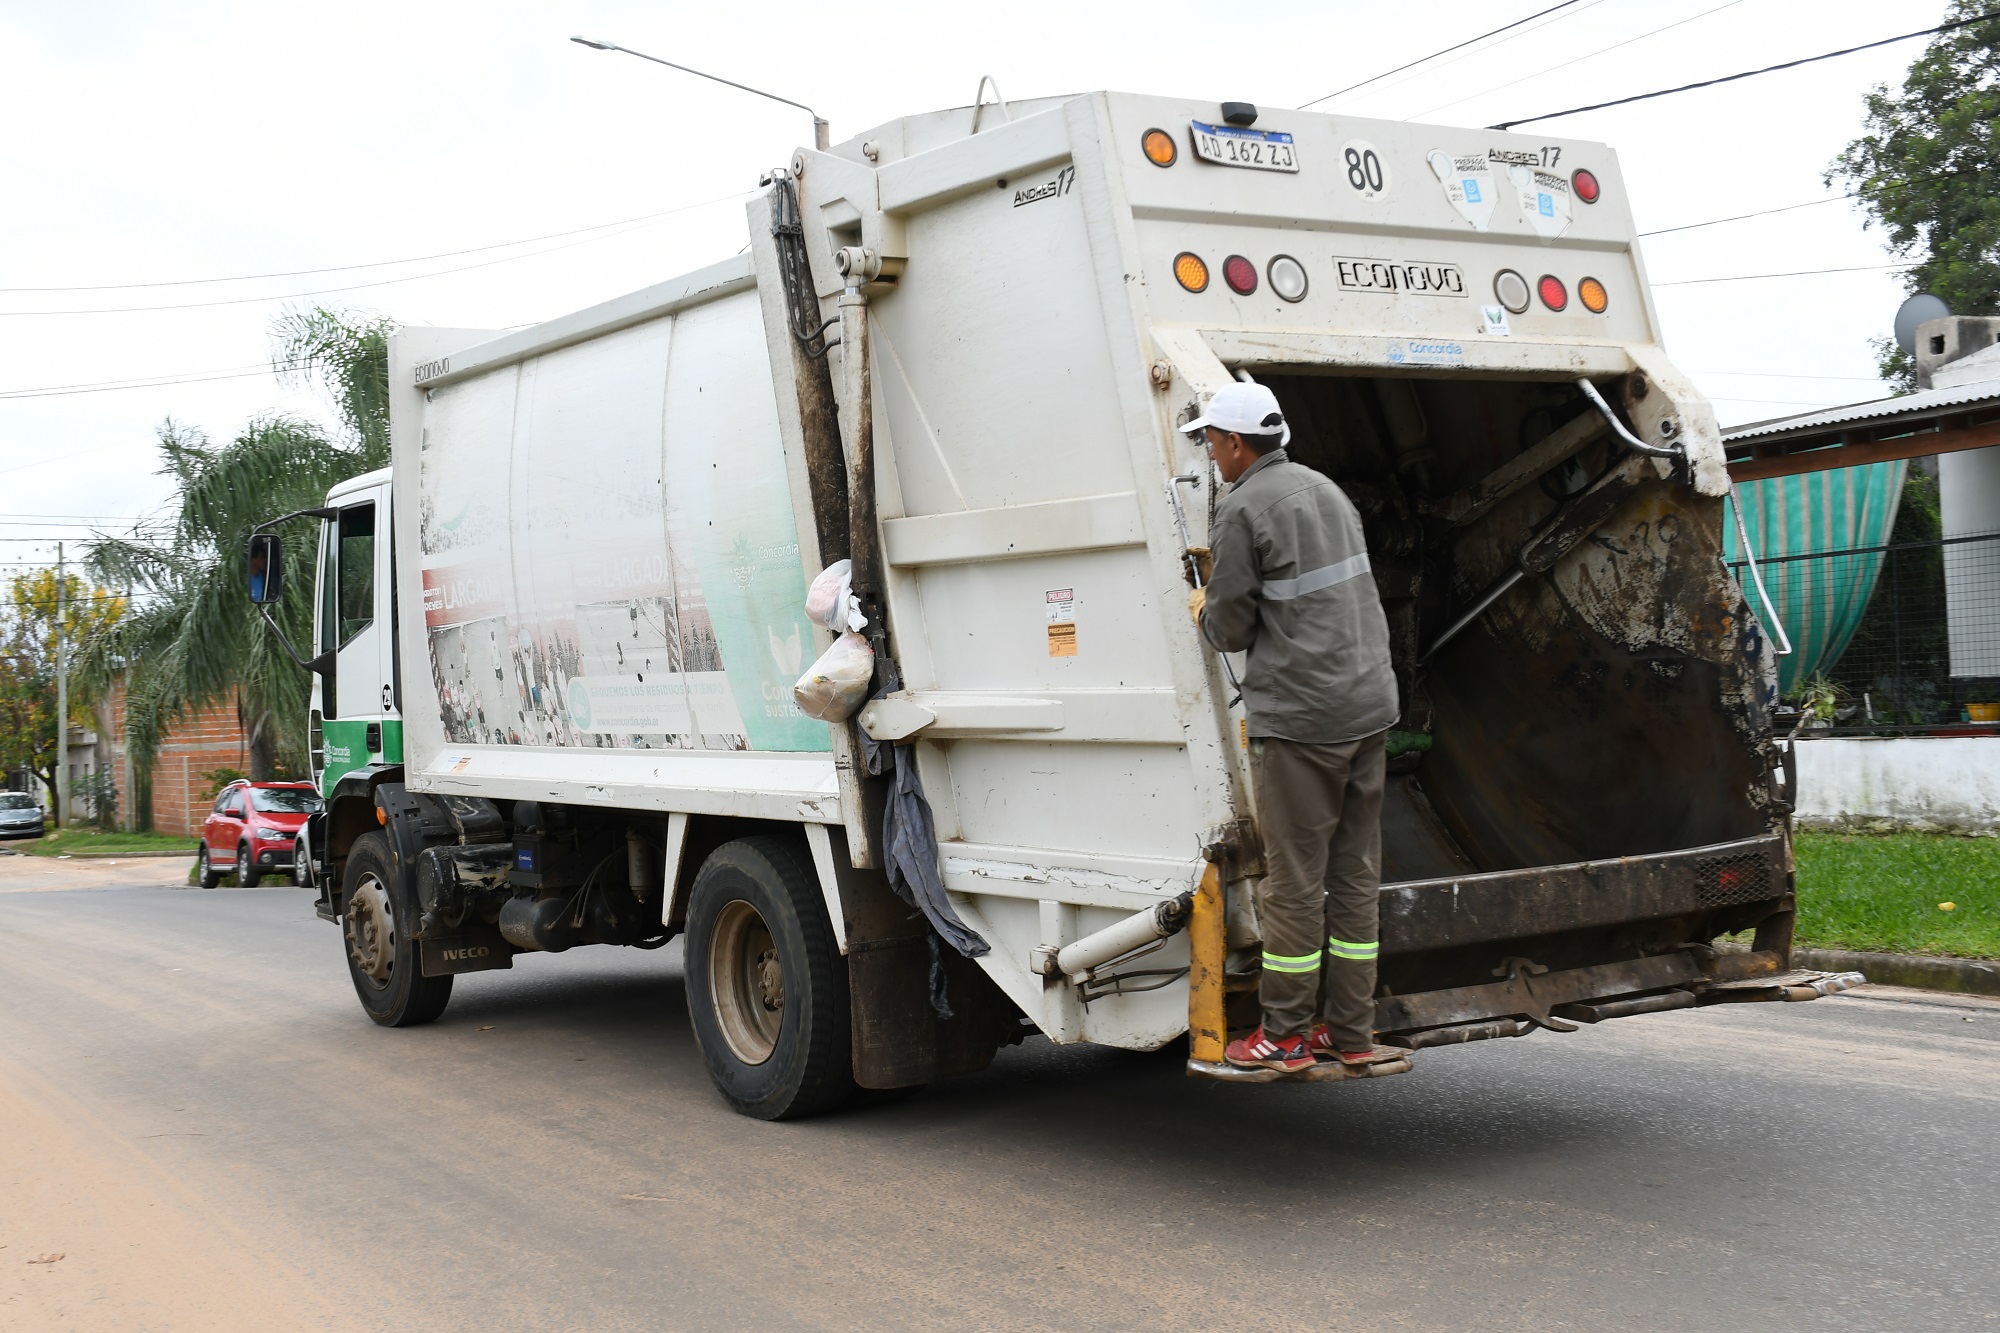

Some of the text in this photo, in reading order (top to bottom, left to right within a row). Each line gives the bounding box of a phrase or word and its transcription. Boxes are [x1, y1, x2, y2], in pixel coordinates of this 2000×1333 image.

[1202, 135, 1293, 166] AD 162 ZJ
[1345, 148, 1383, 192] 80
[1338, 262, 1462, 291] ECONOVO
[1409, 342, 1462, 355] Concordia
[415, 358, 449, 382] ECONOVO
[759, 541, 799, 559] Concordia
[443, 576, 502, 609] LARGADA
[590, 685, 628, 697] SAQUEMOS
[630, 685, 644, 697] LOS
[646, 684, 684, 696] RESIDUOS
[694, 683, 724, 695] TIEMPO
[332, 746, 350, 756] Concordia
[443, 947, 489, 960] IVECO
